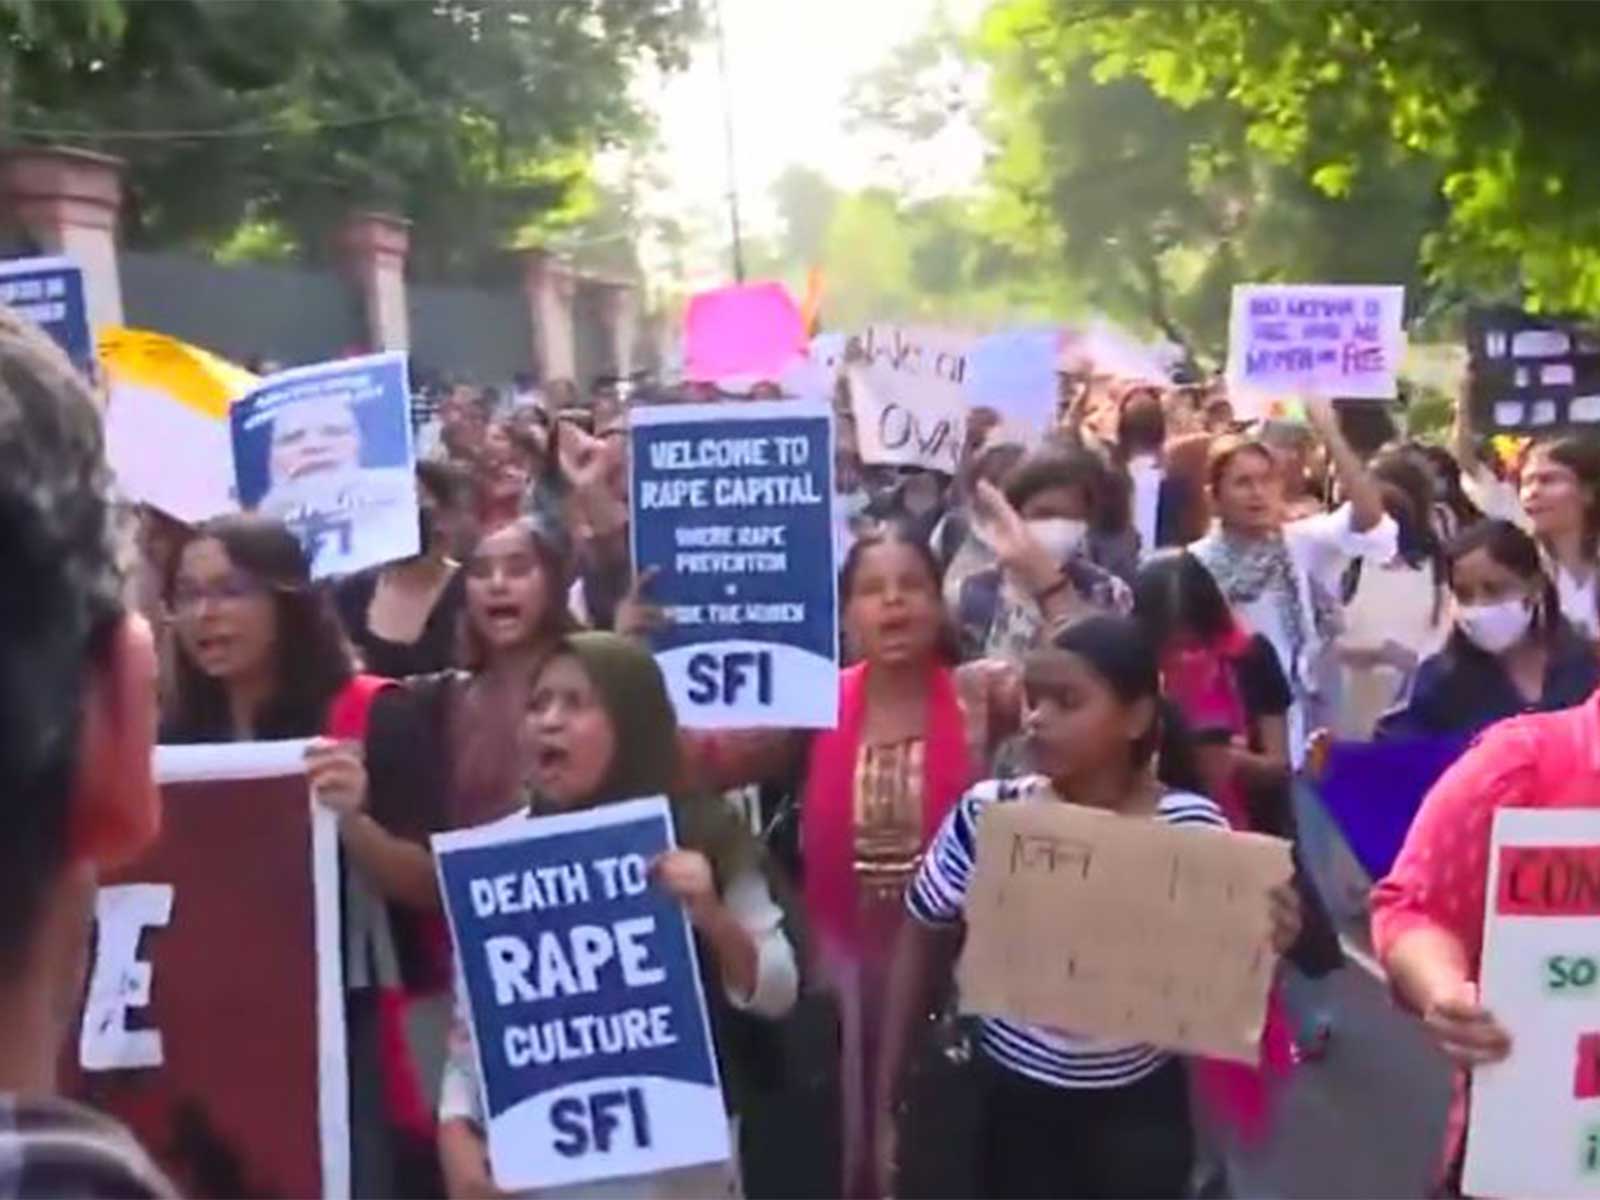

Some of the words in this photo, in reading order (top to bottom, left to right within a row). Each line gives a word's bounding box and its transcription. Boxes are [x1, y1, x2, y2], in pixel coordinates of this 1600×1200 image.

[650, 438, 768, 470] WELCOME
[775, 435, 808, 465] TO
[641, 479, 708, 509] RAPE
[714, 475, 822, 507] CAPITAL
[686, 653, 772, 705] SFI
[470, 863, 589, 917] DEATH
[594, 853, 647, 899] TO
[484, 916, 665, 1006] RAPE
[503, 1006, 678, 1067] CULTURE
[549, 1088, 652, 1159] SFI
